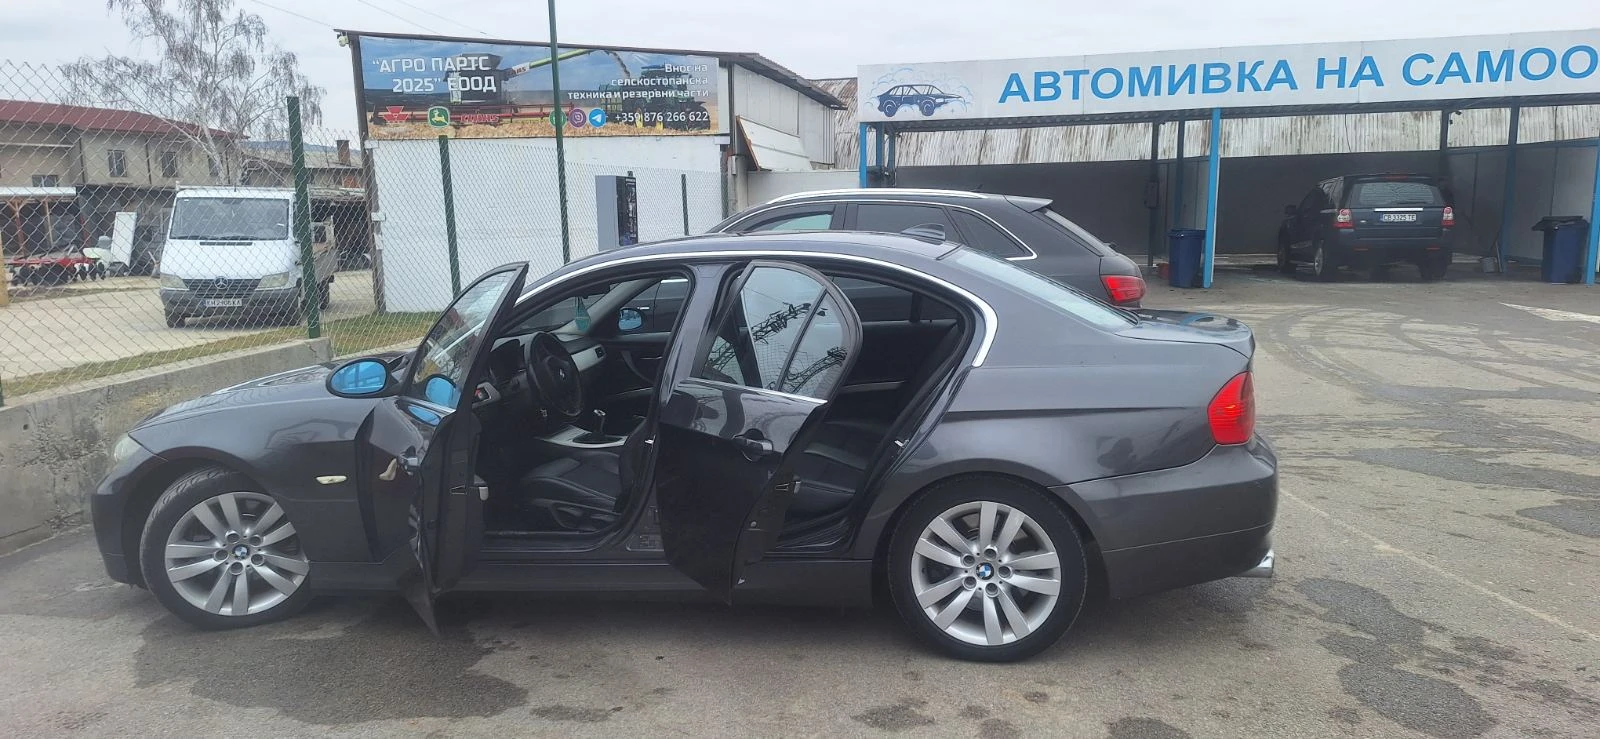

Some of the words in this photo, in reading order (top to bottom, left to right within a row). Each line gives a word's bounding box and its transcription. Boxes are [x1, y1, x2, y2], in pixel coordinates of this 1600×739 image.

[431, 56, 491, 71] ПАРТС
[664, 63, 692, 73] Внос
[998, 59, 1299, 103] АВТОМИВКА
[1315, 55, 1385, 90] НА
[1401, 45, 1599, 87] САМОО
[447, 75, 497, 93] ЕООД
[611, 77, 708, 86] селскостопанска
[568, 91, 612, 100] техника
[622, 90, 676, 99] резервни
[677, 89, 709, 97] части
[615, 112, 641, 122] +359
[644, 112, 664, 122] 876
[666, 111, 686, 121] 266
[688, 111, 709, 121] 622
